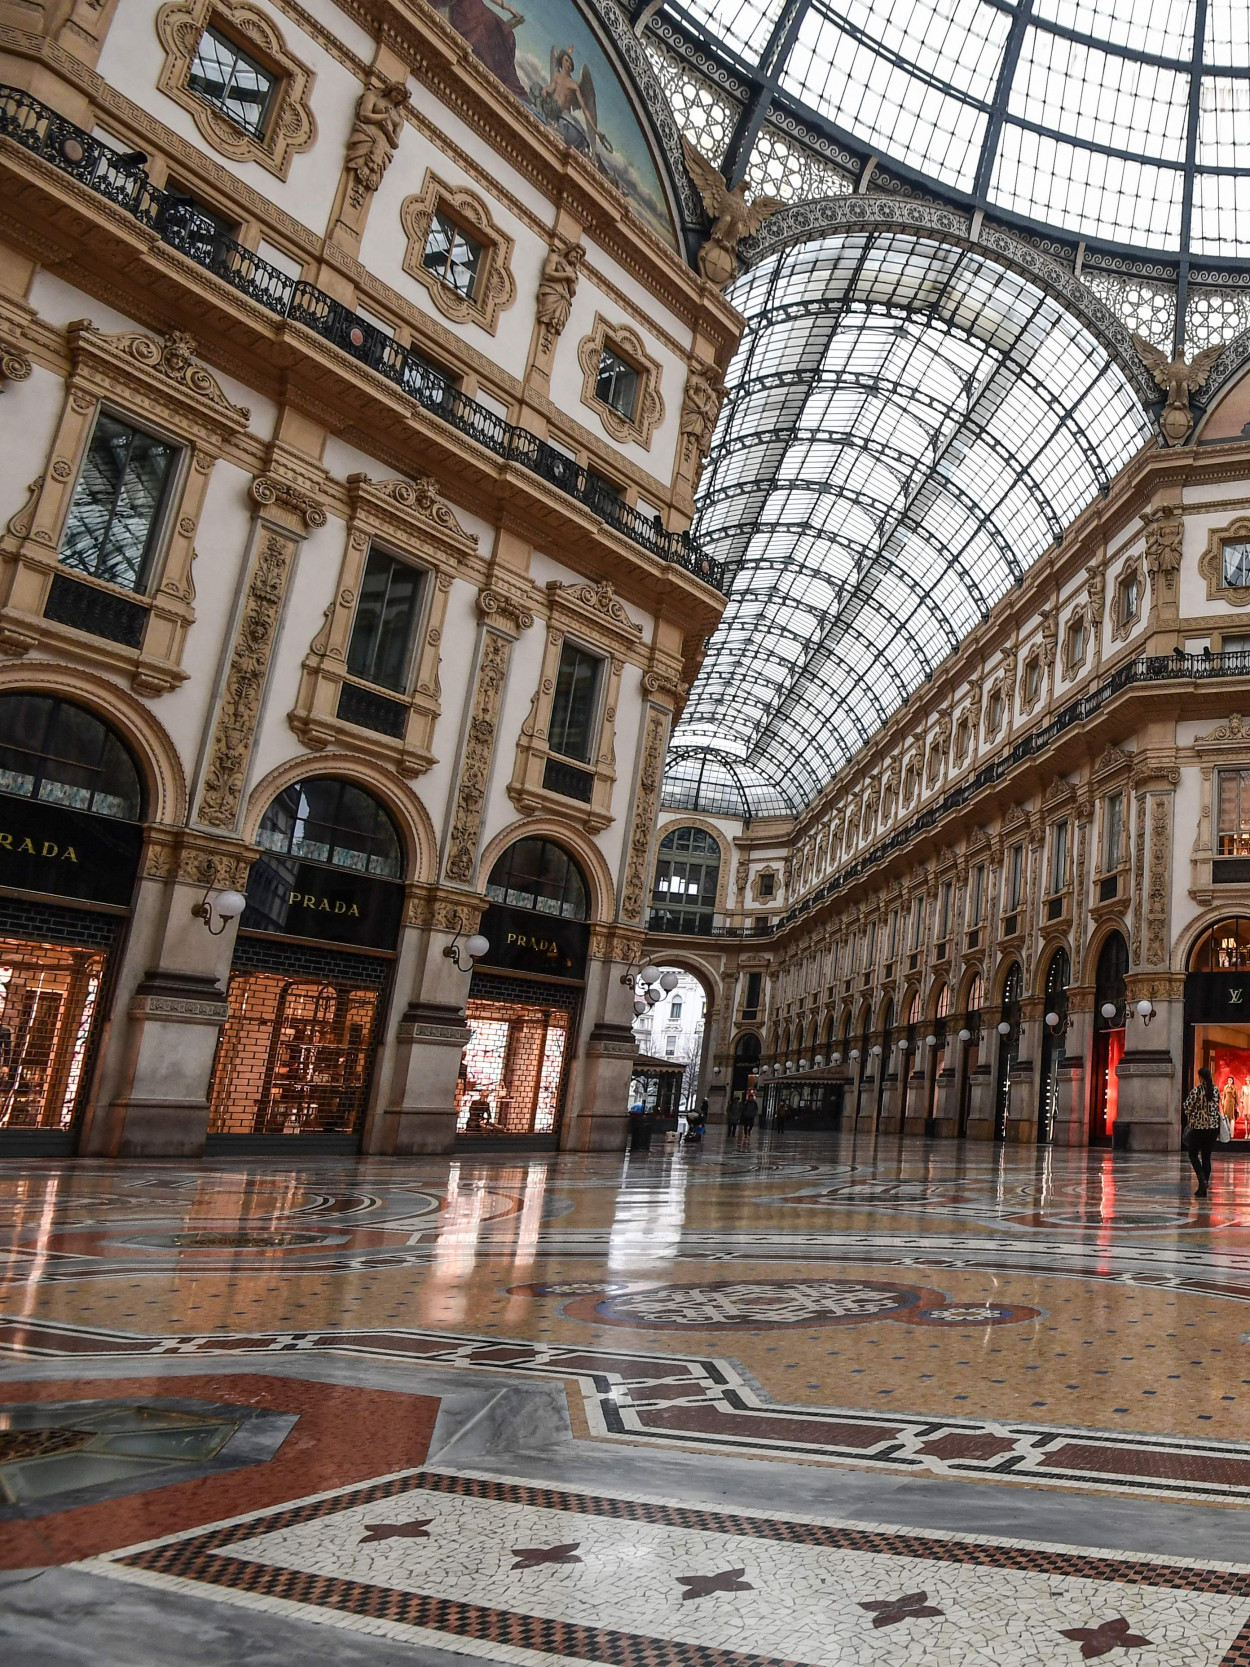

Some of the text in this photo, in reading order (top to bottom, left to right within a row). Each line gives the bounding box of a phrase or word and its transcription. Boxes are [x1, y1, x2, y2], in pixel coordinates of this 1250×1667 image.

[0, 832, 79, 863] RADA
[288, 891, 360, 917] PRADA
[506, 933, 559, 953] PRADA
